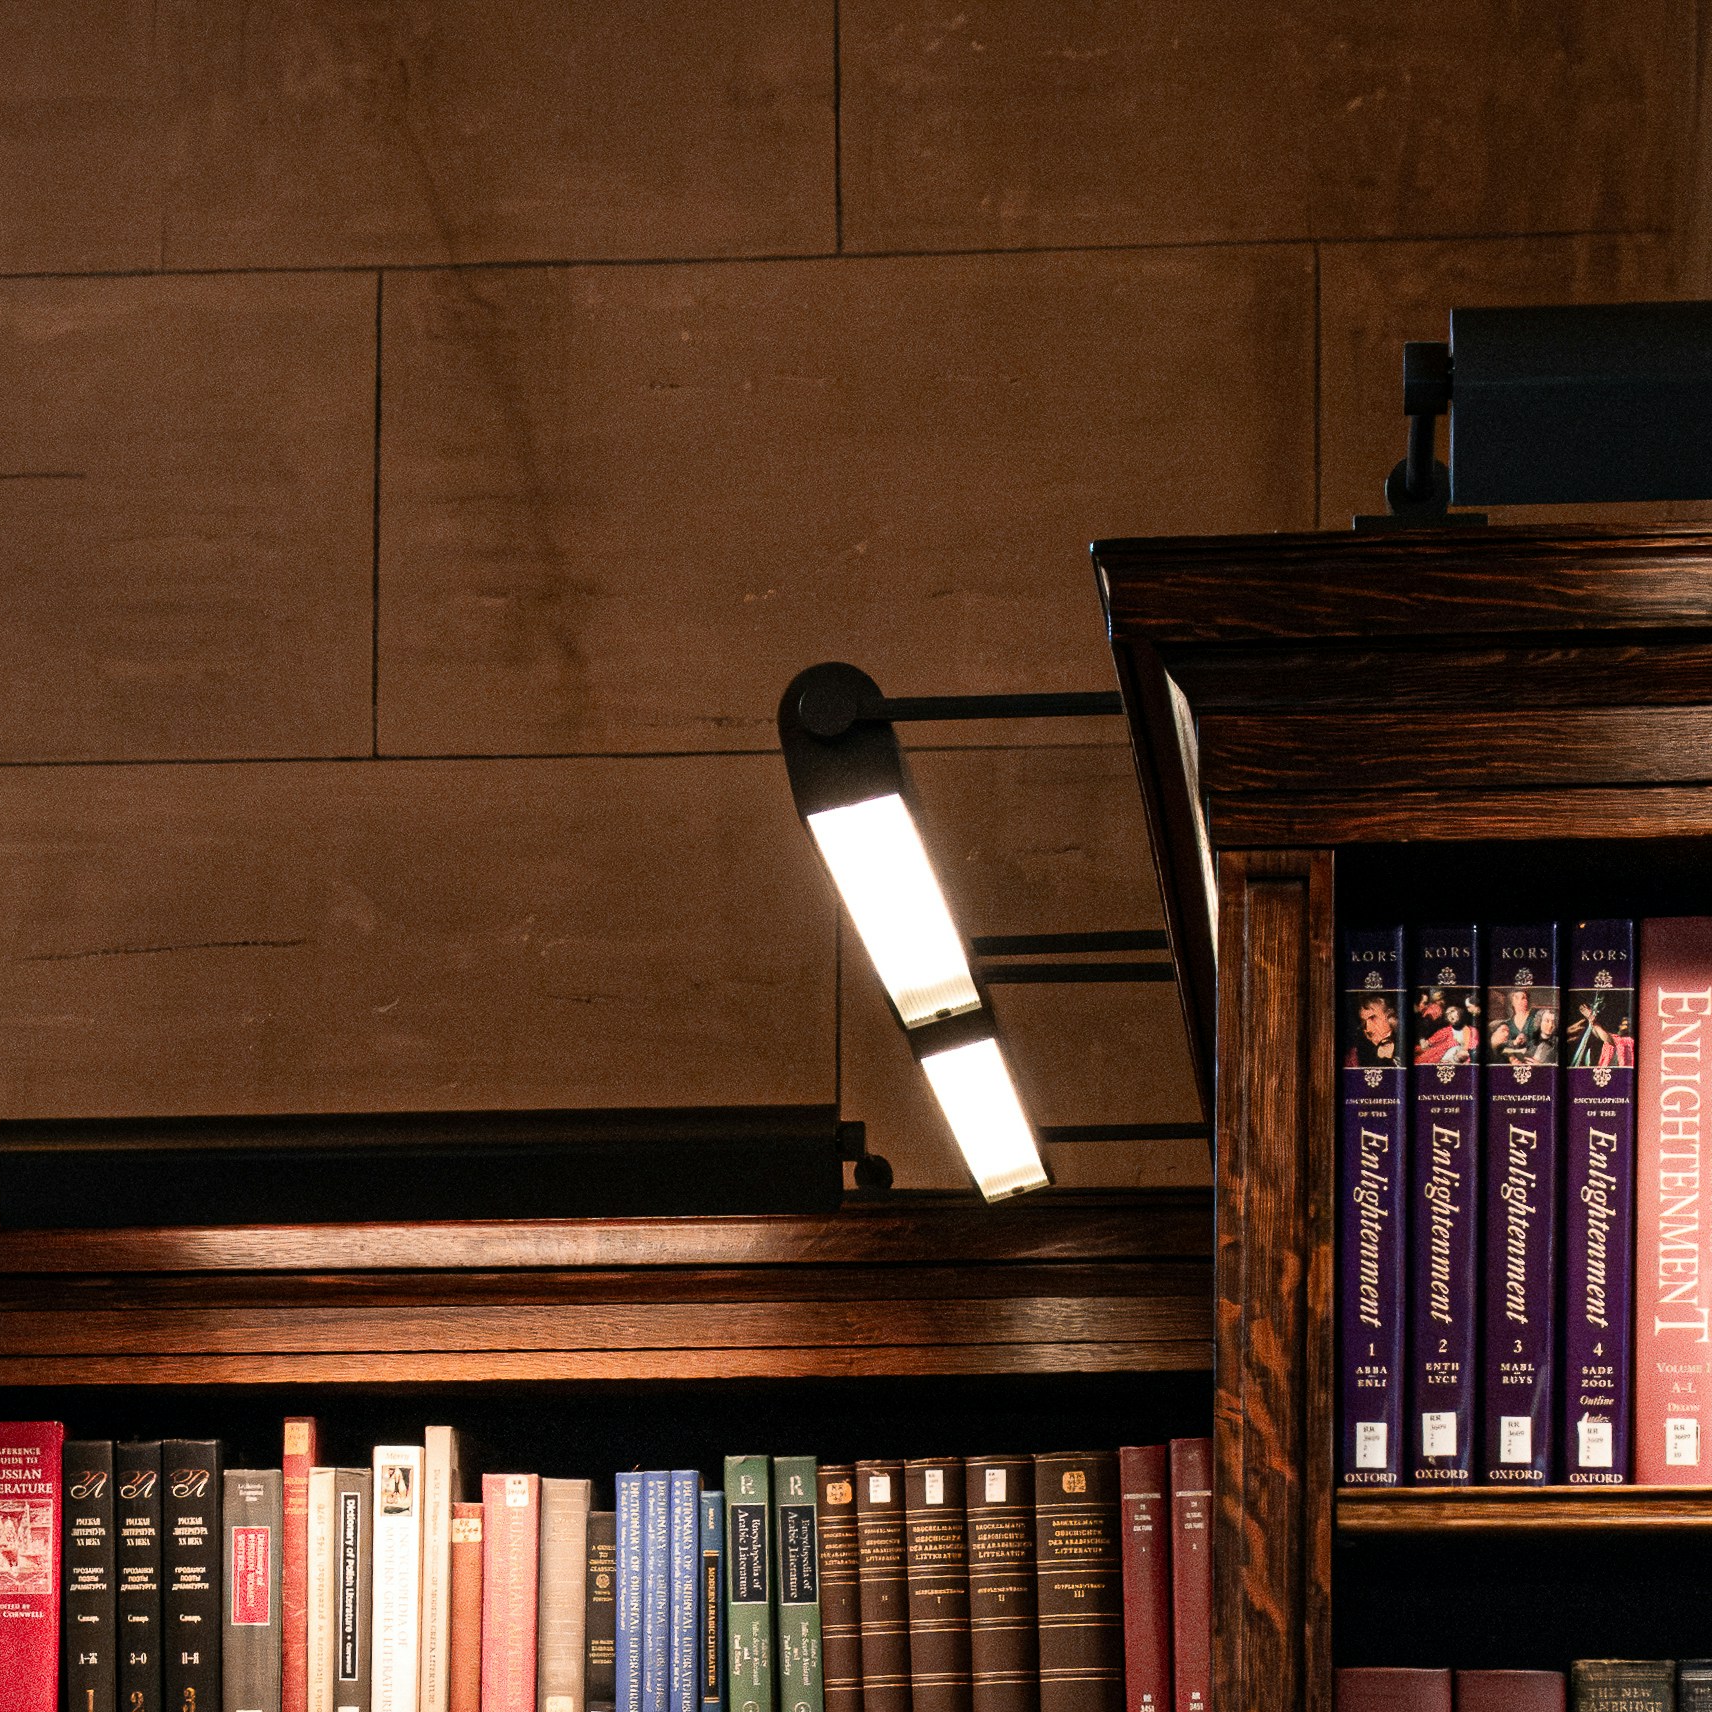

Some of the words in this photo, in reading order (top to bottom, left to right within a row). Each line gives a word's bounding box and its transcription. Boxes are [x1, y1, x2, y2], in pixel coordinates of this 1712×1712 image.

[1352, 951, 1397, 962] KORS
[1424, 947, 1470, 959] KORS
[1502, 947, 1548, 959] KORS
[1582, 950, 1627, 962] KORS
[1654, 986, 1712, 1343] ENLIGHTENMENT
[1353, 1127, 1389, 1328] Enlightenment
[1425, 1124, 1460, 1325] Enlightenment
[1500, 1124, 1536, 1325] Enlightenment
[1580, 1127, 1617, 1329] Enlightenment
[1368, 1342, 1375, 1356] 1
[1438, 1339, 1448, 1353] 2
[1513, 1339, 1523, 1353] 3
[1592, 1342, 1603, 1356] 4
[1356, 1366, 1388, 1375] ABBA
[1425, 1362, 1459, 1371] ENTH
[1500, 1363, 1535, 1372] MABL
[1582, 1366, 1614, 1375] SADE
[1656, 1362, 1702, 1374] VOLUME
[1357, 1379, 1386, 1387] ENLI
[1428, 1375, 1458, 1383] LYCE
[1502, 1375, 1533, 1384] RUYS
[1581, 1379, 1614, 1388] ZOOL
[1344, 1473, 1396, 1483] OXFORD
[1415, 1469, 1468, 1480] OXFORD
[1489, 1470, 1543, 1480] OXFORD
[1569, 1473, 1623, 1484] OXFORD
[344, 1499, 356, 1544] Dictionary
[345, 1546, 356, 1554] of
[344, 1555, 356, 1580] Polish
[345, 1582, 357, 1633] Literature
